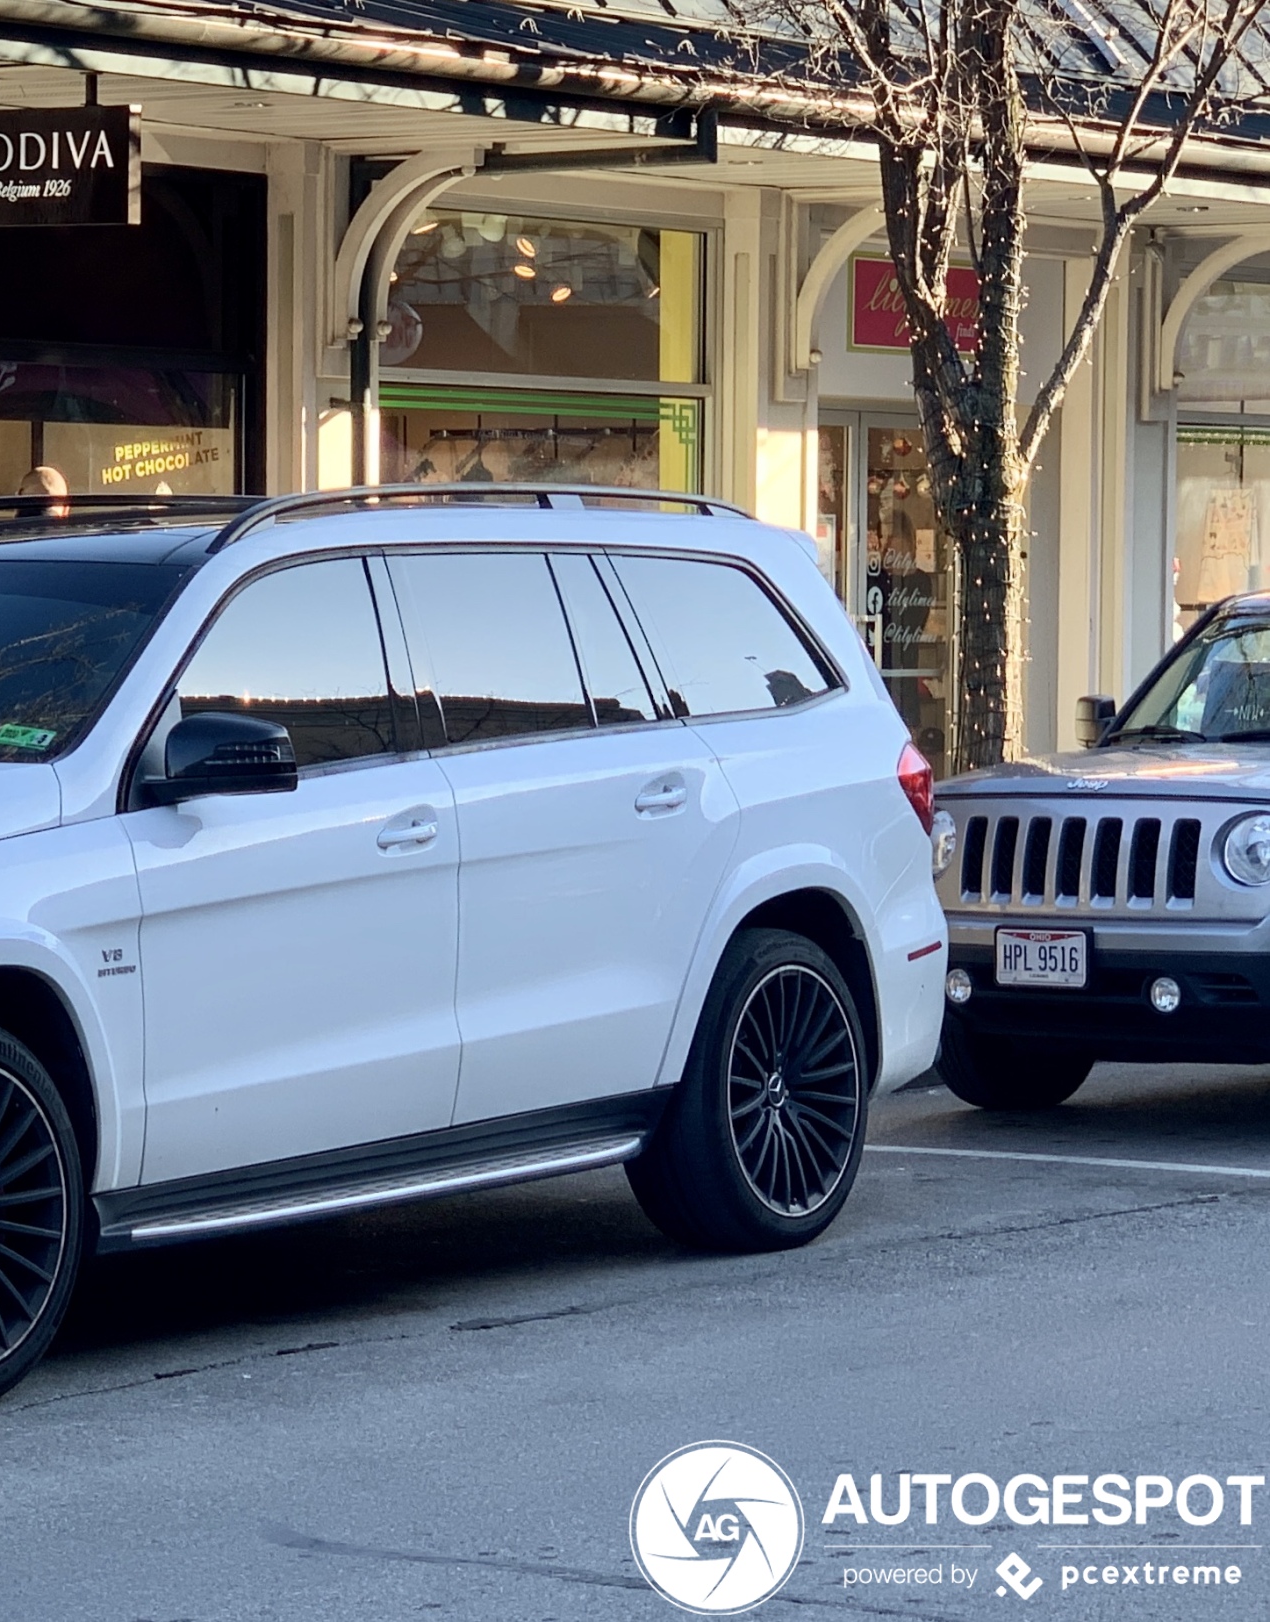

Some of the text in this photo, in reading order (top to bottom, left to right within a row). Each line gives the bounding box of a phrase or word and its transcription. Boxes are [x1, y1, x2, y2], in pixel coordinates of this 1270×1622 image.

[43, 179, 72, 197] 1926
[115, 431, 203, 462] PEPPERMINT
[102, 448, 219, 485] HOT CHOCOLATE
[1067, 778, 1108, 791] Jeep
[1030, 932, 1051, 941] OHIO
[102, 948, 123, 962] V8
[1003, 944, 1079, 972] HPL 9516
